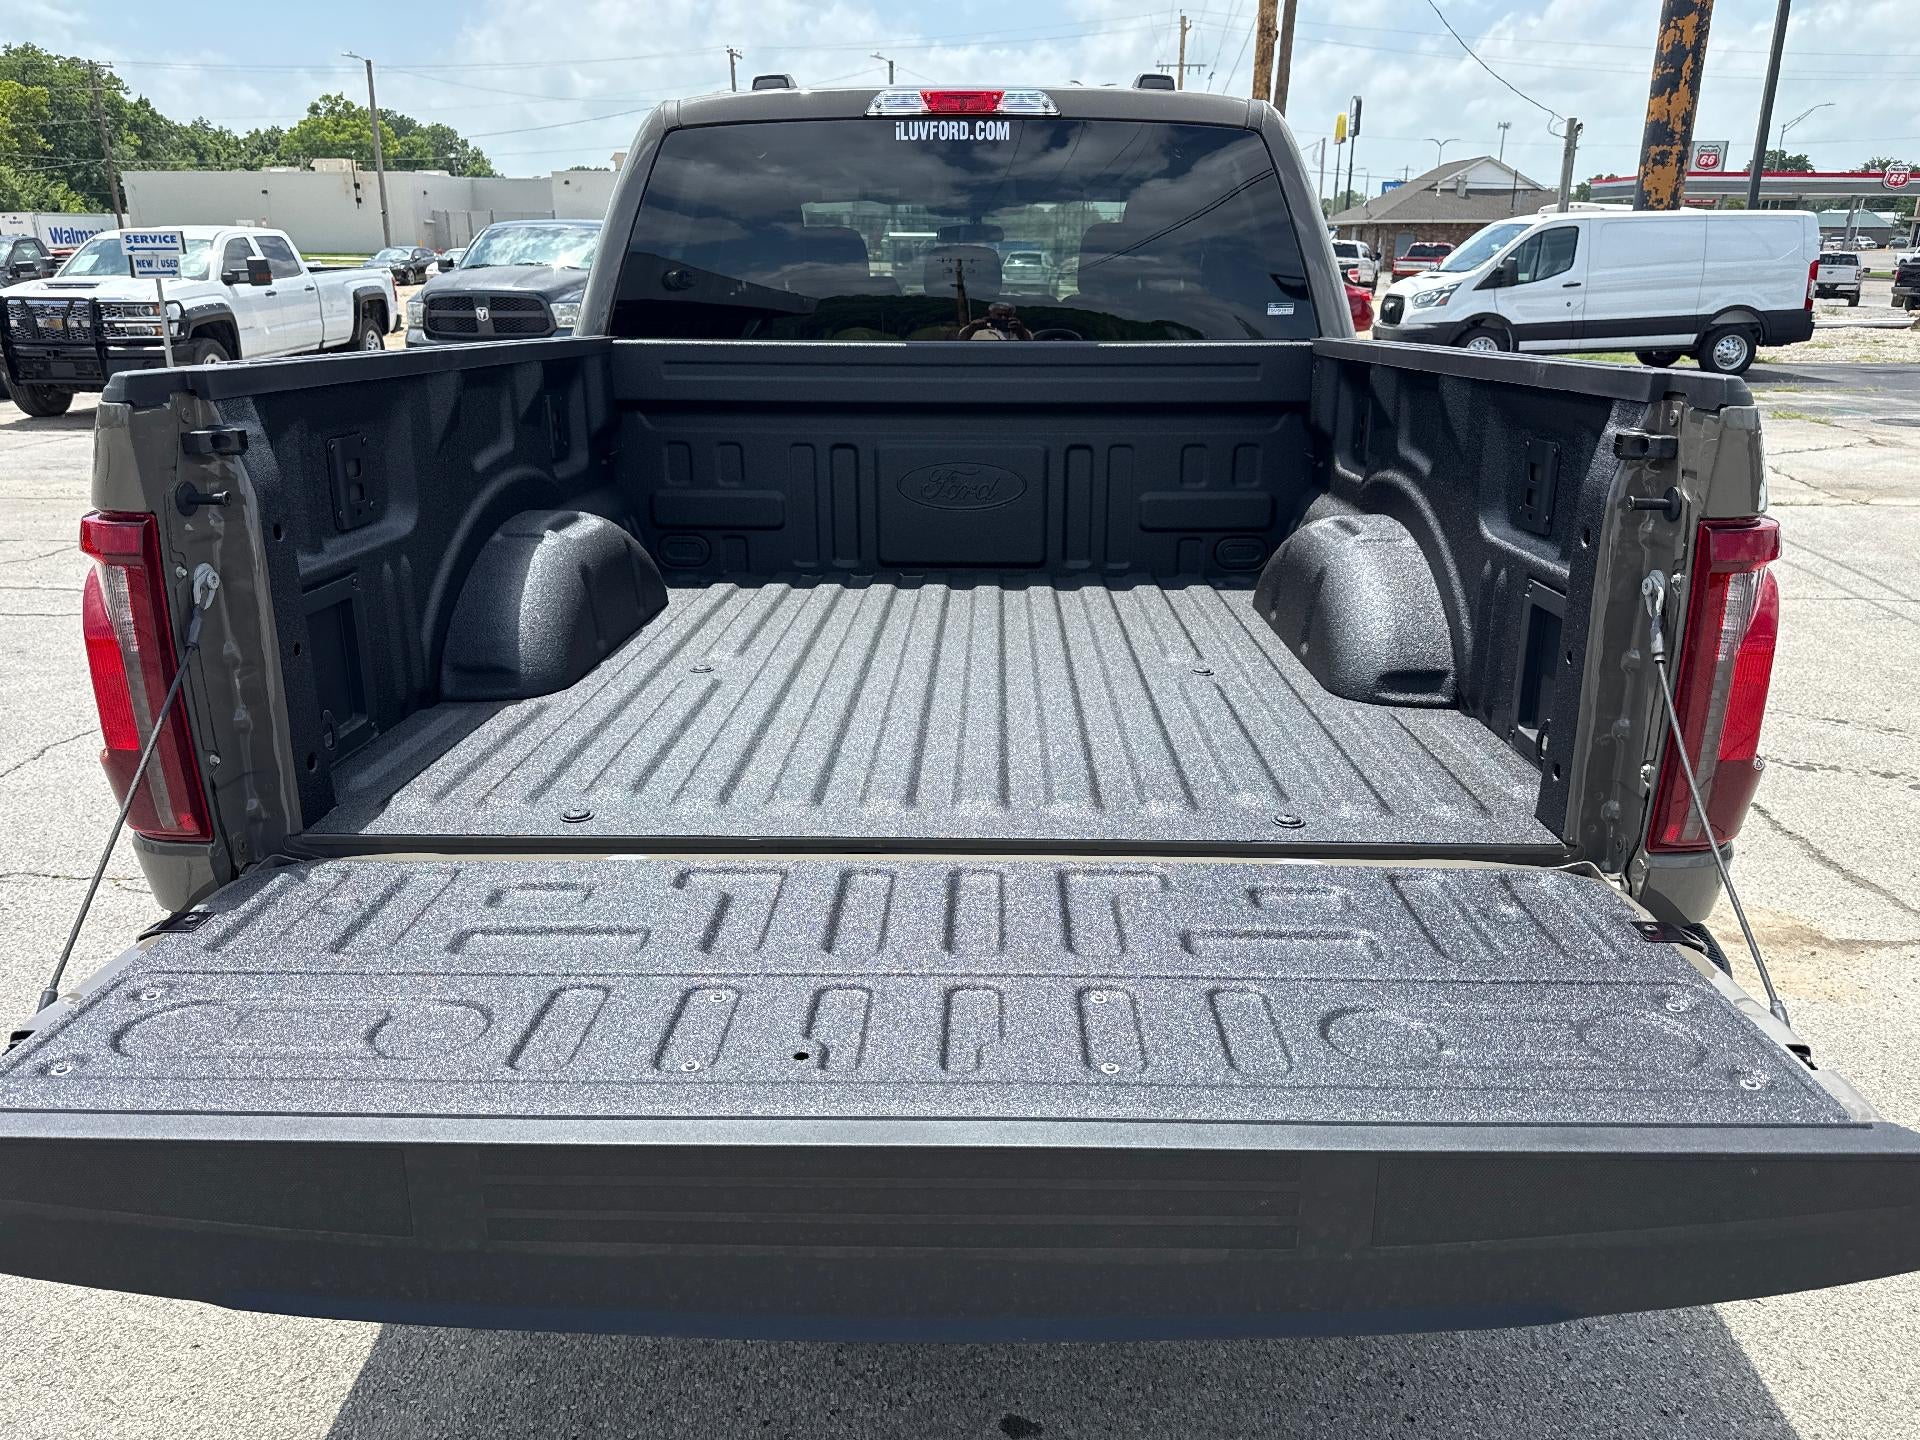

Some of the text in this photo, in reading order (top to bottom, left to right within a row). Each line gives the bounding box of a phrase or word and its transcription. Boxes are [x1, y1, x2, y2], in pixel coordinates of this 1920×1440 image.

[895, 121, 1010, 140] iLUVFORD.COM
[1699, 155, 1716, 165] 66
[1889, 174, 1906, 184] 66
[125, 235, 178, 243] SERVICE
[136, 259, 179, 268] NEW USED
[920, 468, 1001, 501] Ford
